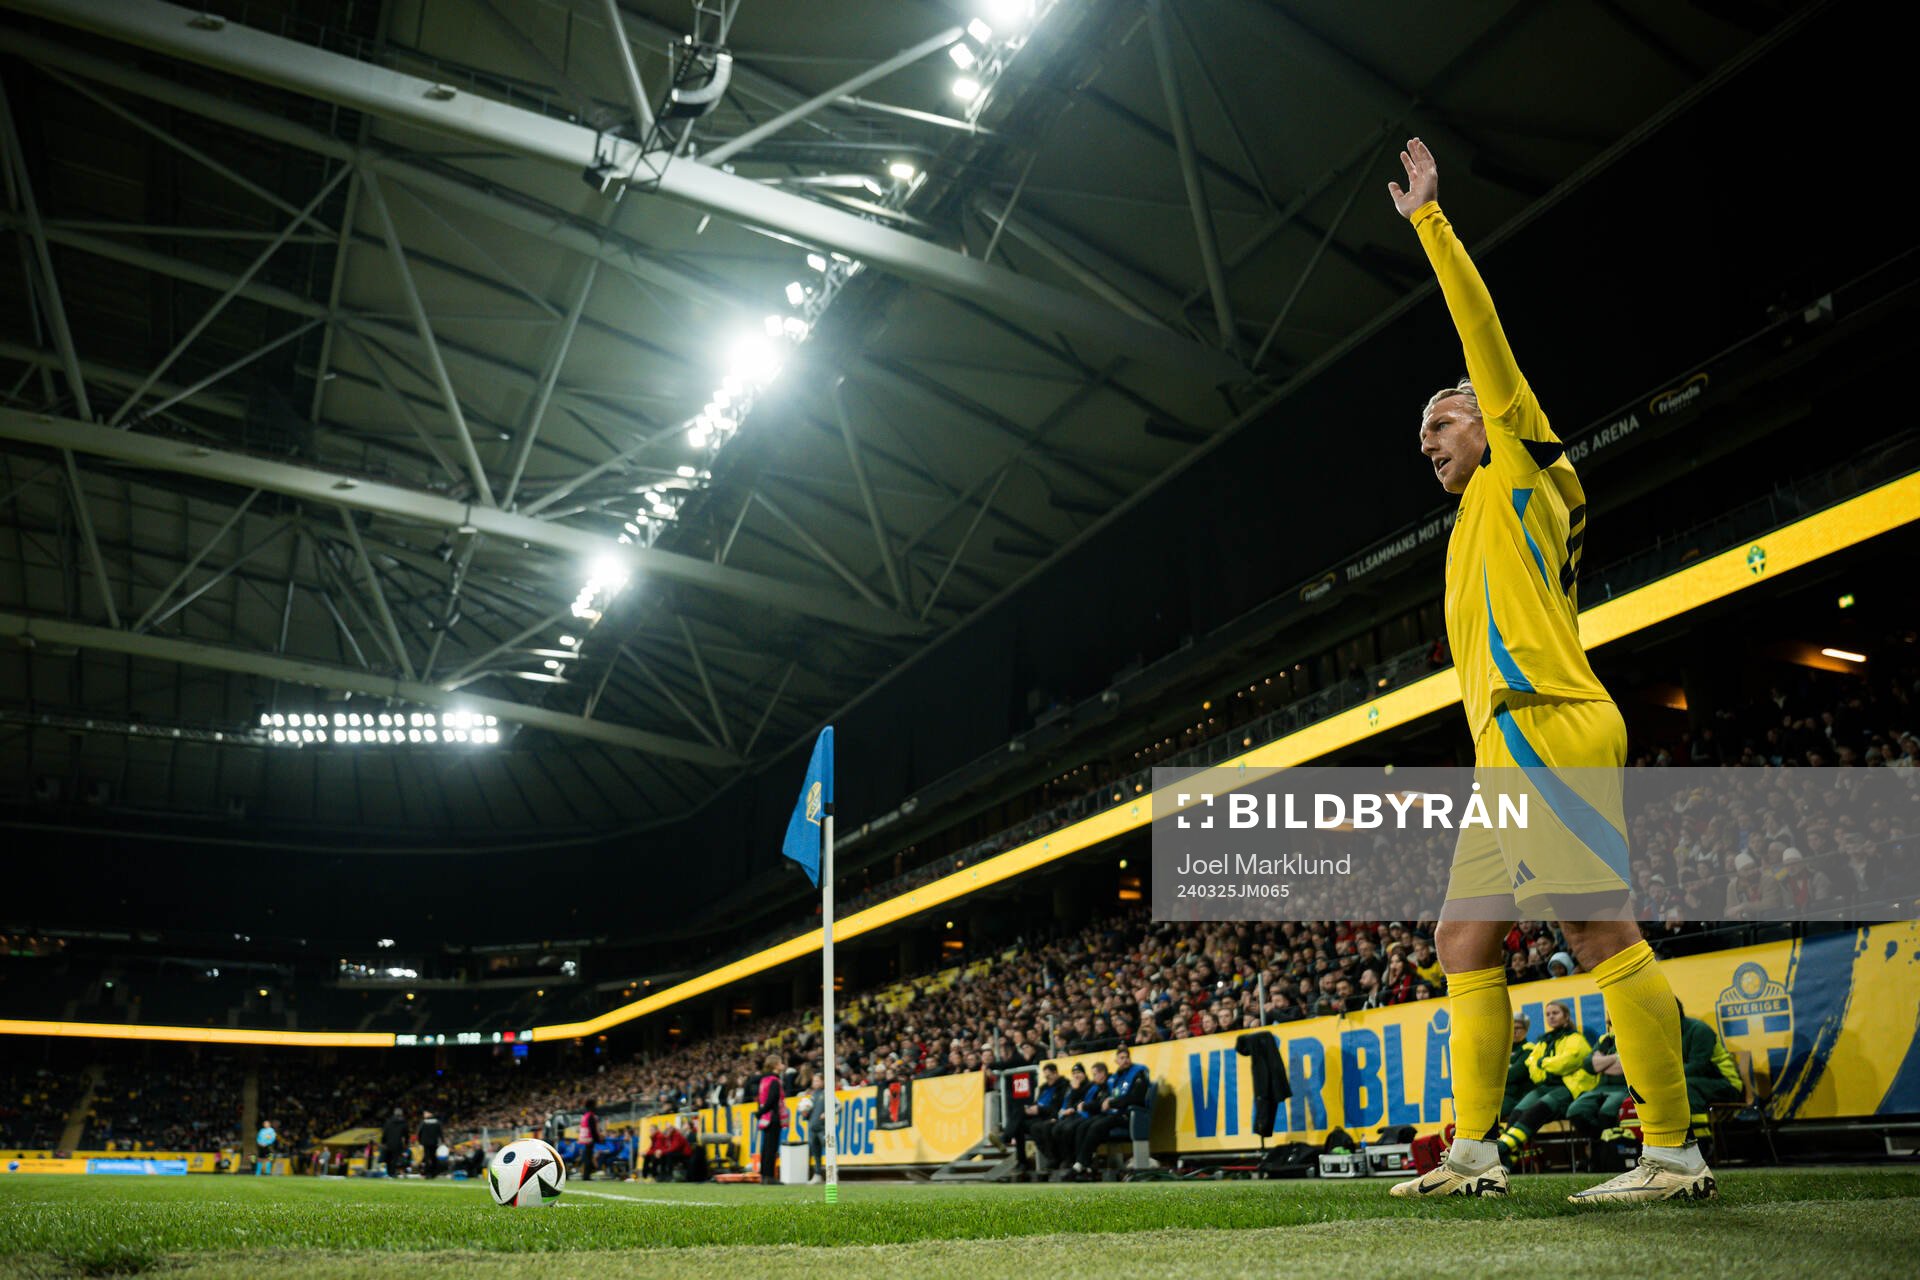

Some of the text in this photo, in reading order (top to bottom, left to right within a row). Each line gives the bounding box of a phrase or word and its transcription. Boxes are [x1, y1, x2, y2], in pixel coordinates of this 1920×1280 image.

[1345, 533, 1417, 581] TILLSAMMANS
[1419, 519, 1440, 544] MOT
[1592, 413, 1640, 451] ARENA
[1727, 999, 1781, 1017] SVERIGE
[1189, 1048, 1239, 1138] VI
